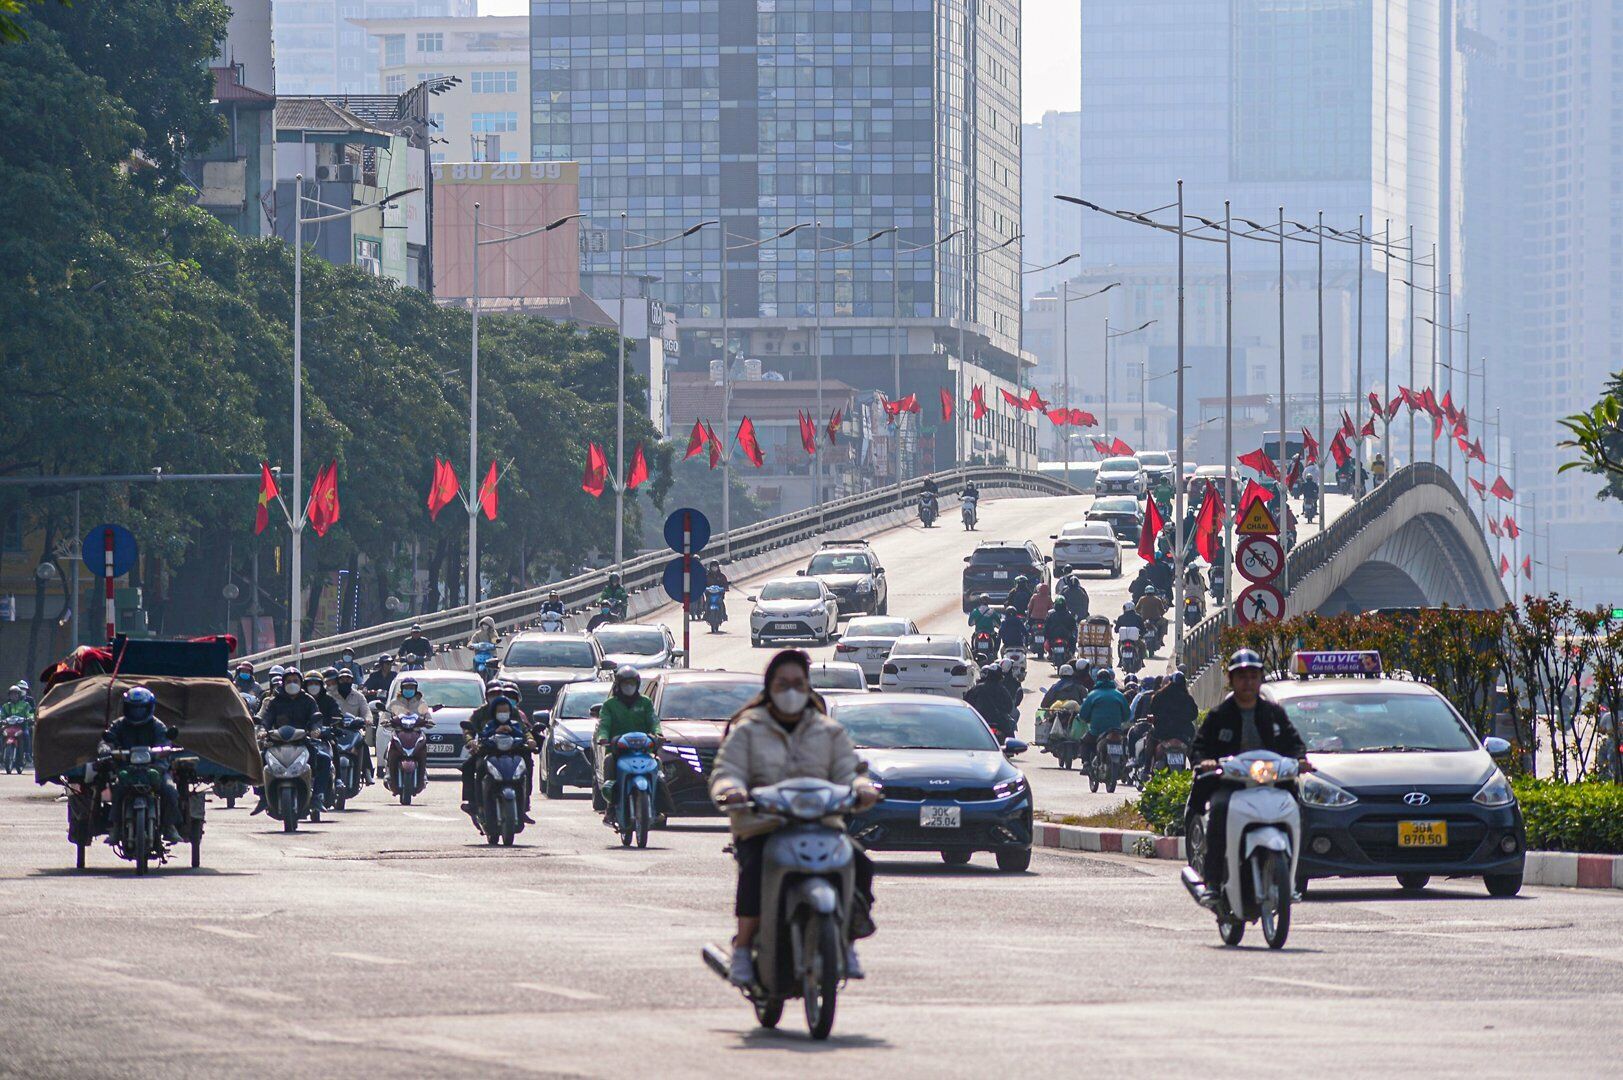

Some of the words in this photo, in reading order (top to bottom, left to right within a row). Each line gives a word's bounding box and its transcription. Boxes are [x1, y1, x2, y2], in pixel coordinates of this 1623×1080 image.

[452, 163, 483, 180] 80
[491, 163, 522, 180] 20
[530, 162, 561, 179] 99
[932, 807, 949, 817] 30K
[925, 816, 956, 826] 25.04
[1412, 822, 1433, 833] 30A
